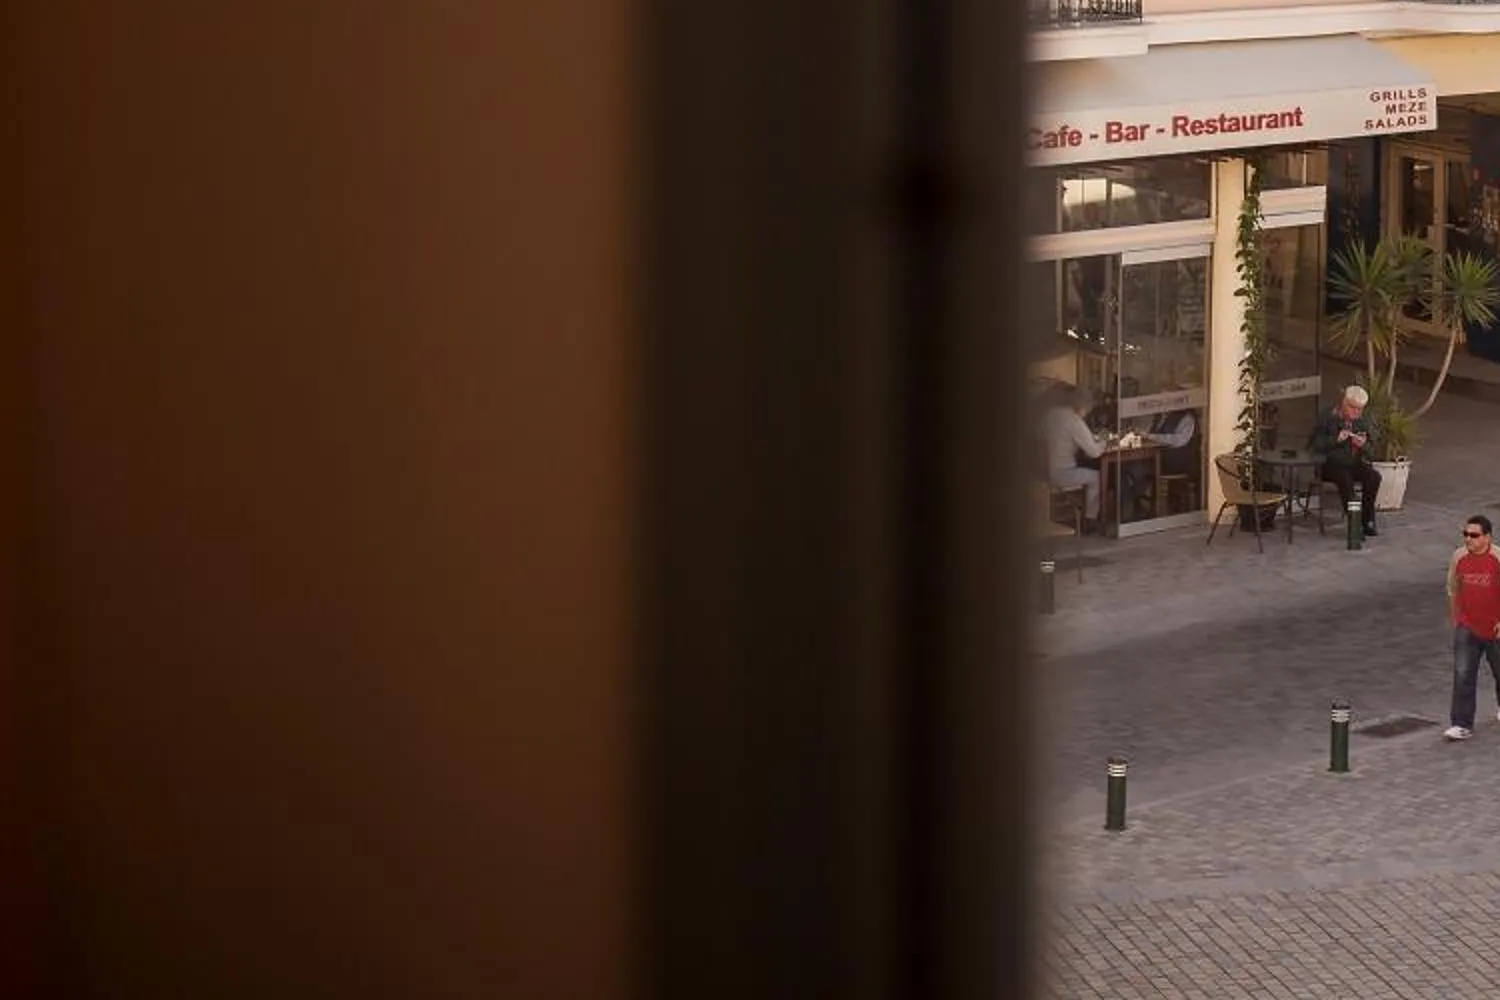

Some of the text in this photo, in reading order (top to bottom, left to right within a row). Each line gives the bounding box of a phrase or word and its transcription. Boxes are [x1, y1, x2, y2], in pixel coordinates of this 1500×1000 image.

[1369, 87, 1427, 102] GRILLS
[1385, 101, 1427, 115] MEZE
[1028, 125, 1082, 149] Cafe
[1105, 121, 1150, 143] Bar
[1171, 107, 1303, 137] Restaurant
[1364, 115, 1427, 129] SALADS
